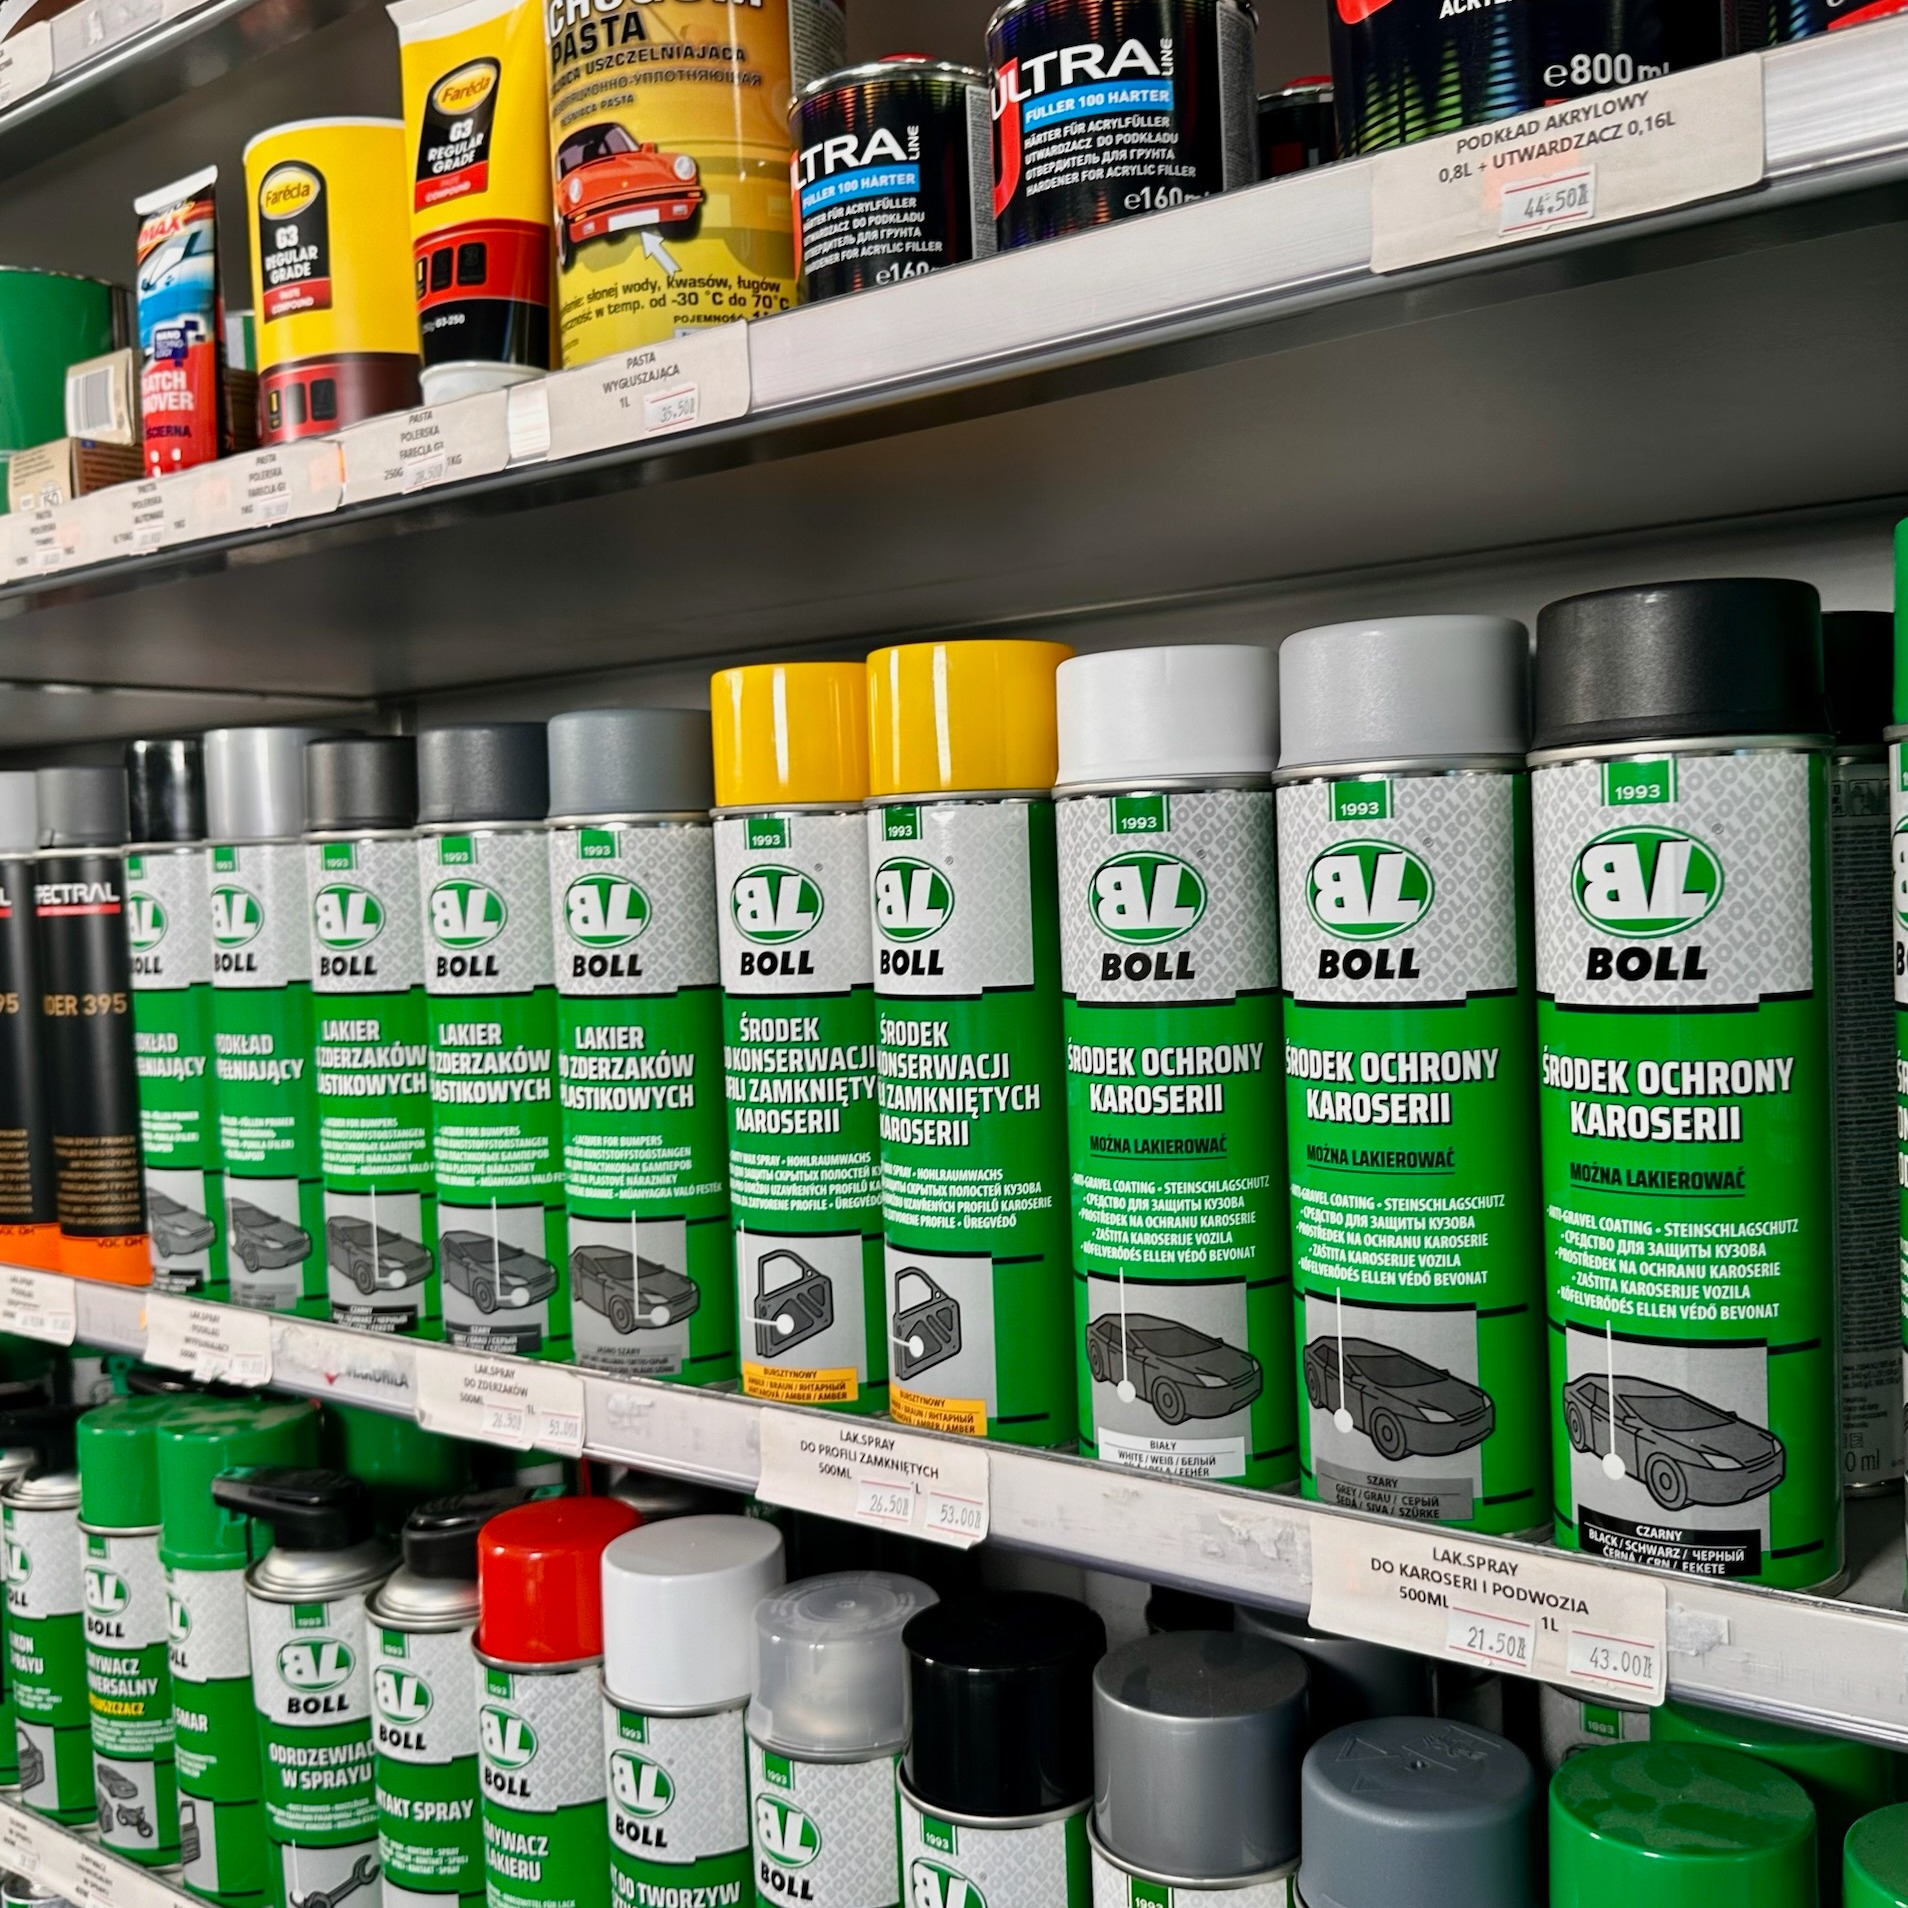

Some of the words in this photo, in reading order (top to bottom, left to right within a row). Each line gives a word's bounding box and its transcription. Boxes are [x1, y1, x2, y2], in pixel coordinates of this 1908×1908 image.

[552, 11, 646, 74] PASTA
[1160, 38, 1174, 77] LINE
[441, 76, 492, 104] Farécla
[990, 39, 1161, 121] ULTRA
[1077, 92, 1104, 108] 100
[449, 118, 474, 142] G3
[1064, 121, 1087, 137] FÜR
[1088, 114, 1170, 134] ACRYLFÜLLER
[1456, 120, 1540, 154] PODKŁAD
[1546, 90, 1650, 132] AKRYLOWY
[427, 132, 485, 163] REGULAR
[907, 125, 920, 161] LINE
[1025, 140, 1093, 166] UTWARDZACZ
[1097, 134, 1114, 148] DO
[1115, 132, 1179, 146] PODKŁADU
[1438, 163, 1473, 184] 0,8L
[1478, 162, 1488, 172] +
[1493, 124, 1622, 169] UTWARDZACZ
[1628, 111, 1676, 137] 0,16L
[432, 149, 476, 175] GRADE
[1025, 152, 1101, 181] ОТВЕРДИТЕЛЬ
[1102, 149, 1127, 165] ДЛЯ
[1129, 148, 1175, 161] ГРУНТА
[838, 181, 859, 195] 100
[1026, 171, 1080, 198] HARDENER
[1081, 167, 1104, 182] FOR
[1106, 163, 1156, 179] ACRYLIC
[1157, 164, 1197, 178] FILLER
[265, 183, 311, 208] Farécla
[140, 216, 183, 246] MAX
[853, 217, 867, 230] DO
[867, 212, 925, 227] PODKŁADU
[275, 225, 299, 250] G3
[265, 245, 319, 271] REGULAR
[841, 249, 859, 262] FOR
[860, 244, 904, 258] ACRYLIC
[905, 241, 943, 253] FILLER
[270, 263, 312, 285] GRADE
[622, 278, 662, 295] wody,
[667, 275, 732, 291] kwasów,
[737, 276, 781, 294] ługów
[608, 300, 645, 317] temp.
[650, 295, 666, 308] od
[672, 292, 699, 307] -30
[729, 293, 747, 307] do
[435, 314, 466, 328] G3-250
[626, 352, 656, 369] PASTA
[603, 364, 681, 394] WYGŁUSZAJĄCA
[619, 396, 631, 408] 1L
[408, 411, 432, 425] PASTA
[400, 426, 440, 442] POLERSKA
[1615, 784, 1661, 800] 1993
[1340, 802, 1379, 816] 1993
[1121, 817, 1157, 830] 1993
[437, 955, 499, 977] BOLL
[573, 954, 643, 978] BOLL
[740, 950, 814, 976] BOLL
[880, 949, 944, 976] BOLL
[1101, 951, 1195, 981] BOLL
[1318, 948, 1420, 980] BOLL
[1586, 946, 1708, 982] BOLL
[84, 992, 127, 1016] 395
[439, 1023, 502, 1046] LAKIER
[575, 1026, 645, 1050] LAKIER
[740, 1011, 820, 1042] ŚRODEK
[880, 1012, 949, 1047] ŚRODEK
[570, 1049, 694, 1081] ZDERZAKÓW
[732, 1045, 876, 1073] KONSERWACJI
[1068, 1037, 1135, 1076] ŚRODEK
[1141, 1042, 1264, 1077] OCHRONY
[1286, 1038, 1354, 1082] ŚRODEK
[1360, 1048, 1500, 1083] OCHRONY
[1542, 1044, 1630, 1095] ŚRODEK
[1637, 1057, 1795, 1096] OCHRONY
[887, 1083, 1040, 1120] ZAMKNIĘTYCH
[1090, 1083, 1222, 1114] KAROSERII
[1306, 1088, 1452, 1124] KAROSERII
[736, 1107, 840, 1134] KAROSERII
[880, 1113, 969, 1146] KAROSERII
[1570, 1100, 1741, 1141] KAROSERII
[1134, 1133, 1227, 1154] LAKIEROWAĆ
[1307, 1143, 1348, 1165] MOŻNA
[1352, 1147, 1456, 1168] LAKIEROWAĆ
[917, 1167, 1003, 1181] HOHLRAUMWACHS
[1570, 1161, 1621, 1187] MOŻNA
[1626, 1166, 1746, 1190] LAKIEROWAĆ
[1384, 1194, 1505, 1211] STEINSCHLAGSCHUTZ
[1599, 1216, 1652, 1236] COATING
[1664, 1218, 1798, 1238] STEINSCHLAGSCHUTZ
[1565, 1230, 1615, 1251] СРЕДСТВО
[1617, 1239, 1644, 1256] ДЛЯ
[1648, 1242, 1712, 1260] ЗАЩИТЫ
[1715, 1242, 1767, 1258] КУЗОВА
[1557, 1248, 1616, 1272] PROSTŘEDEK
[1619, 1260, 1637, 1275] NA
[1639, 1261, 1706, 1279] OCHRANU
[1710, 1261, 1781, 1280] KAROSERIE
[1577, 1271, 1618, 1293] ZAŠTITA
[1620, 1282, 1700, 1300] KAROSERIJE
[1703, 1285, 1750, 1300] VOZILA
[1636, 1302, 1677, 1319] ELLEN
[1721, 1303, 1779, 1321] BEVONAT
[477, 1380, 528, 1397] ZDERZAKÓW
[839, 1429, 895, 1451] LAK.SPRAY
[1150, 1440, 1177, 1450] BIAŁY
[801, 1440, 815, 1453] DO
[819, 1444, 857, 1462] PROFILI
[860, 1453, 939, 1480] ZAMKNIĘTYCH
[819, 1462, 852, 1480] 500ML
[1366, 1475, 1398, 1488] SZARY
[1335, 1483, 1356, 1497] GREY
[1364, 1490, 1391, 1503] GRAU
[1402, 1496, 1439, 1507] СЕРЫЙ
[1399, 1507, 1439, 1519] SZÜRKE
[1588, 1528, 1618, 1547] BLACK
[1625, 1539, 1681, 1560] SCHWARZ
[1692, 1549, 1744, 1562] ЧЕРНЫЙ
[1636, 1525, 1682, 1542] CZARNY
[1433, 1546, 1518, 1577] LAK.SPRAY
[1682, 1561, 1725, 1575] FEKETE
[1371, 1557, 1394, 1575] DO
[1399, 1562, 1478, 1593] KAROSERI
[1482, 1580, 1487, 1594] I
[1492, 1584, 1590, 1616] PODWOZIA
[1399, 1587, 1450, 1609] 500ML
[1541, 1616, 1559, 1632] 1L
[288, 1694, 349, 1714] BOLL
[379, 1725, 427, 1751] BOLL
[622, 1727, 641, 1740] 1993
[302, 1764, 372, 1790] SPRAYU
[484, 1766, 531, 1797] BOLL
[767, 1769, 788, 1785] 1993
[414, 1799, 474, 1822] SPRAY
[616, 1814, 668, 1848] BOLL
[926, 1832, 950, 1850] 1993
[486, 1844, 542, 1882] LAKIERU
[761, 1861, 814, 1900] BOLL
[637, 1881, 741, 1908] TWORZYW
